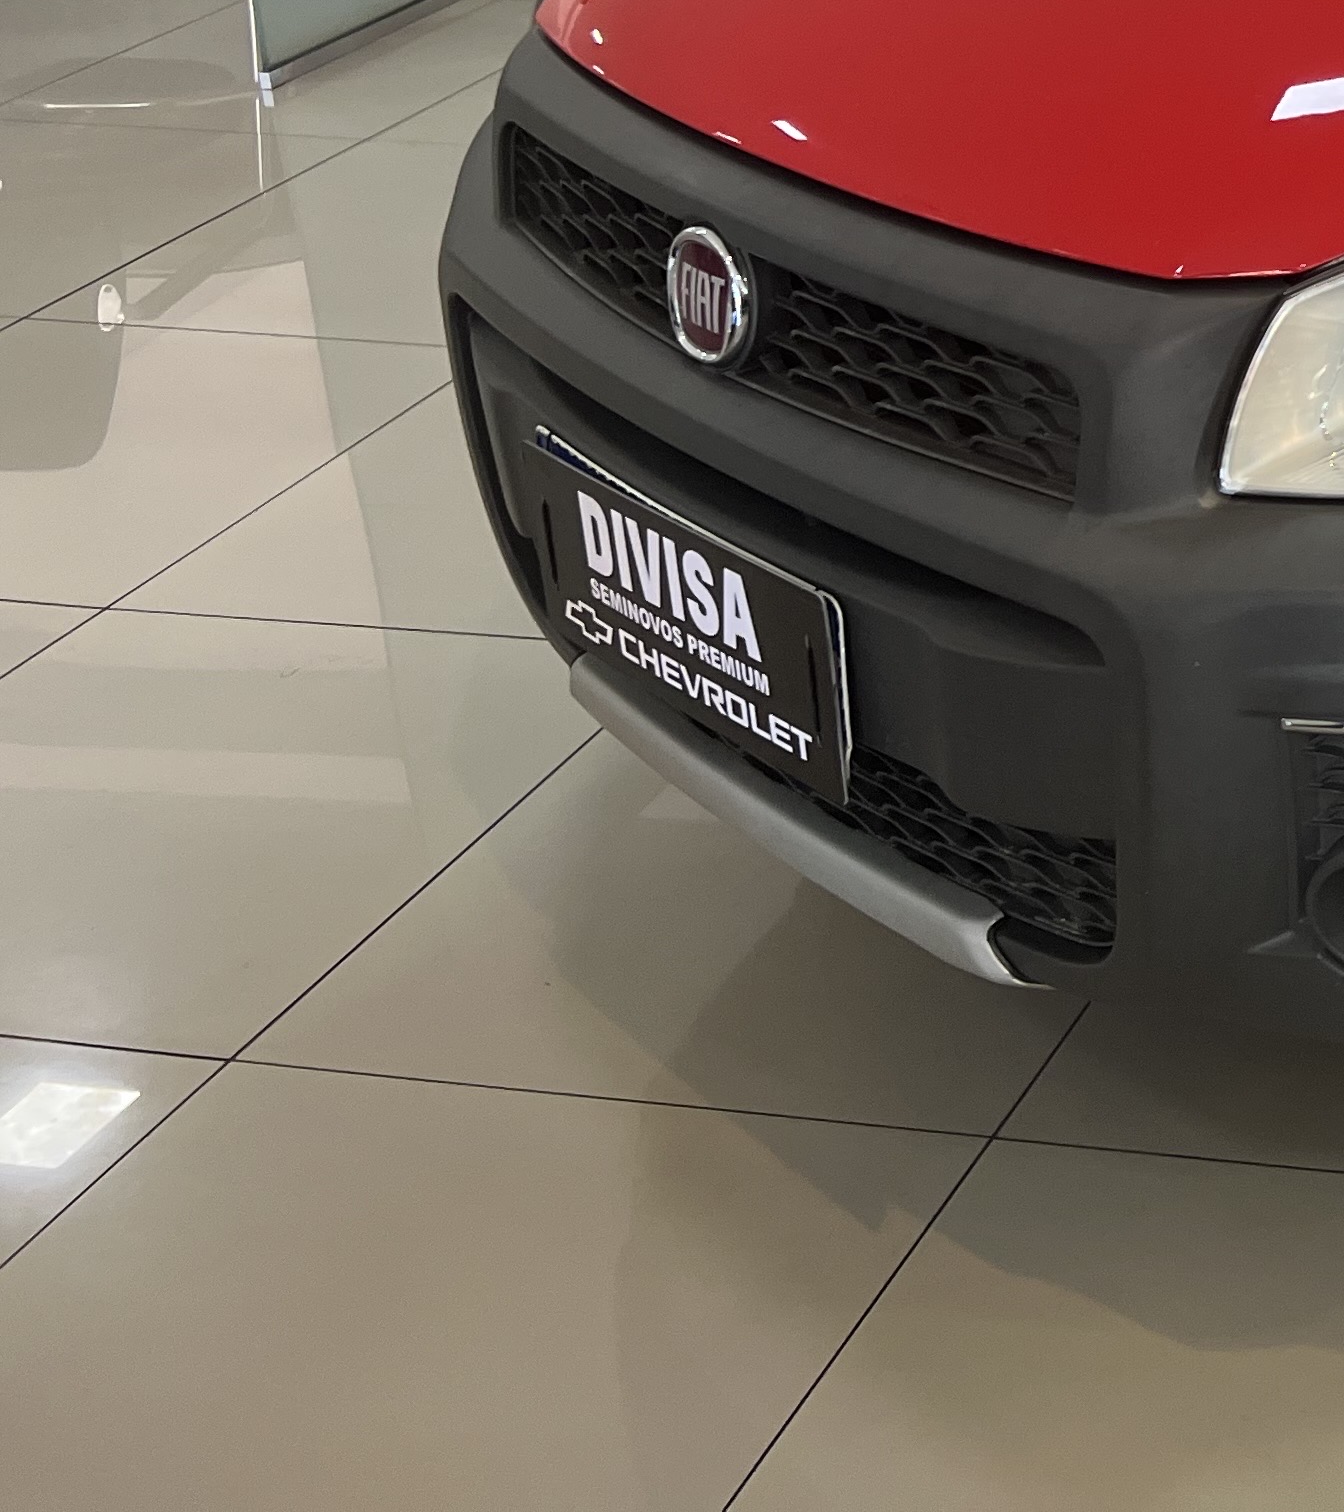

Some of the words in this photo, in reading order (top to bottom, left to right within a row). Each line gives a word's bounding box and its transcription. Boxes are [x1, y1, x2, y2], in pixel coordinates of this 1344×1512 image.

[681, 261, 725, 334] FIAT
[577, 491, 762, 663] DIVISA
[590, 578, 684, 649] SEMINOVOS
[686, 634, 770, 696] PREMIUM
[619, 628, 813, 761] CHEVROLET
